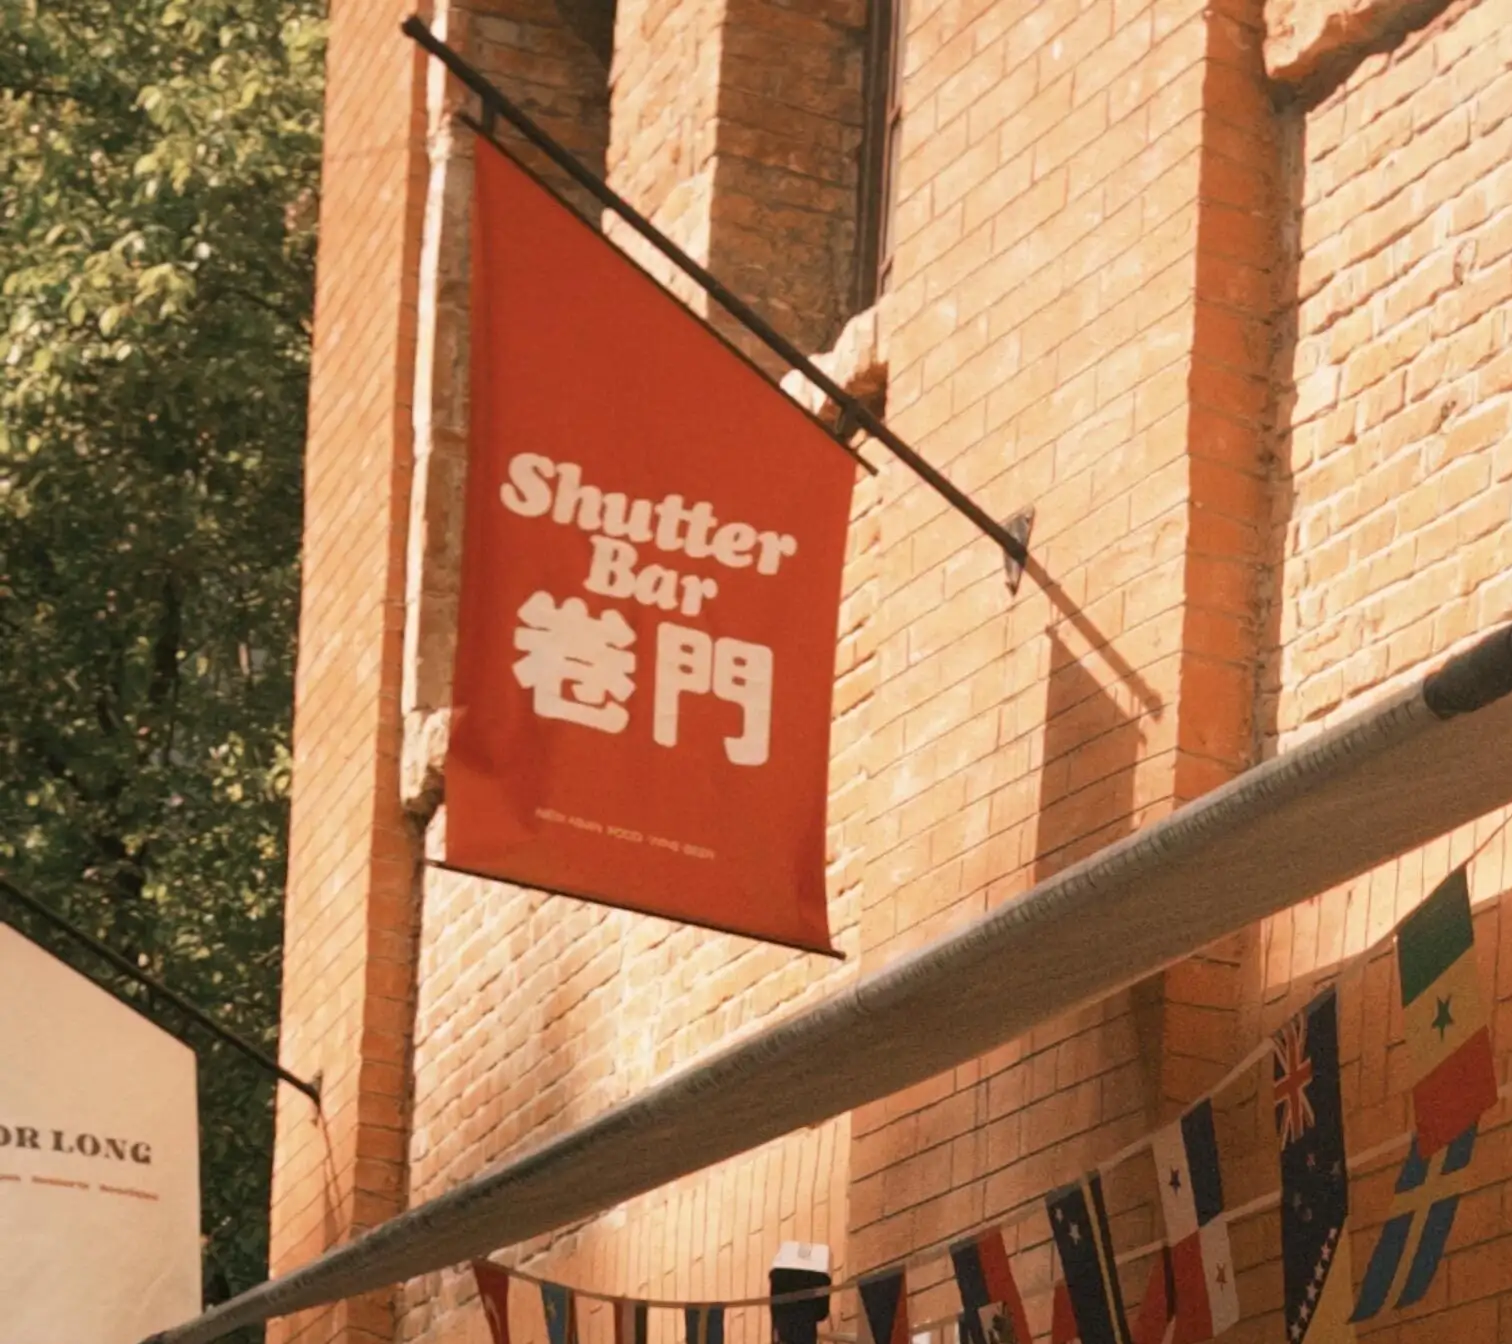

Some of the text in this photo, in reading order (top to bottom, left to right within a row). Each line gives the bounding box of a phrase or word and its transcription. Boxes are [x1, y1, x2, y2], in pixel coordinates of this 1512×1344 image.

[500, 451, 798, 575] Shutter
[583, 534, 718, 616] Bar
[51, 1128, 152, 1166] LONG
